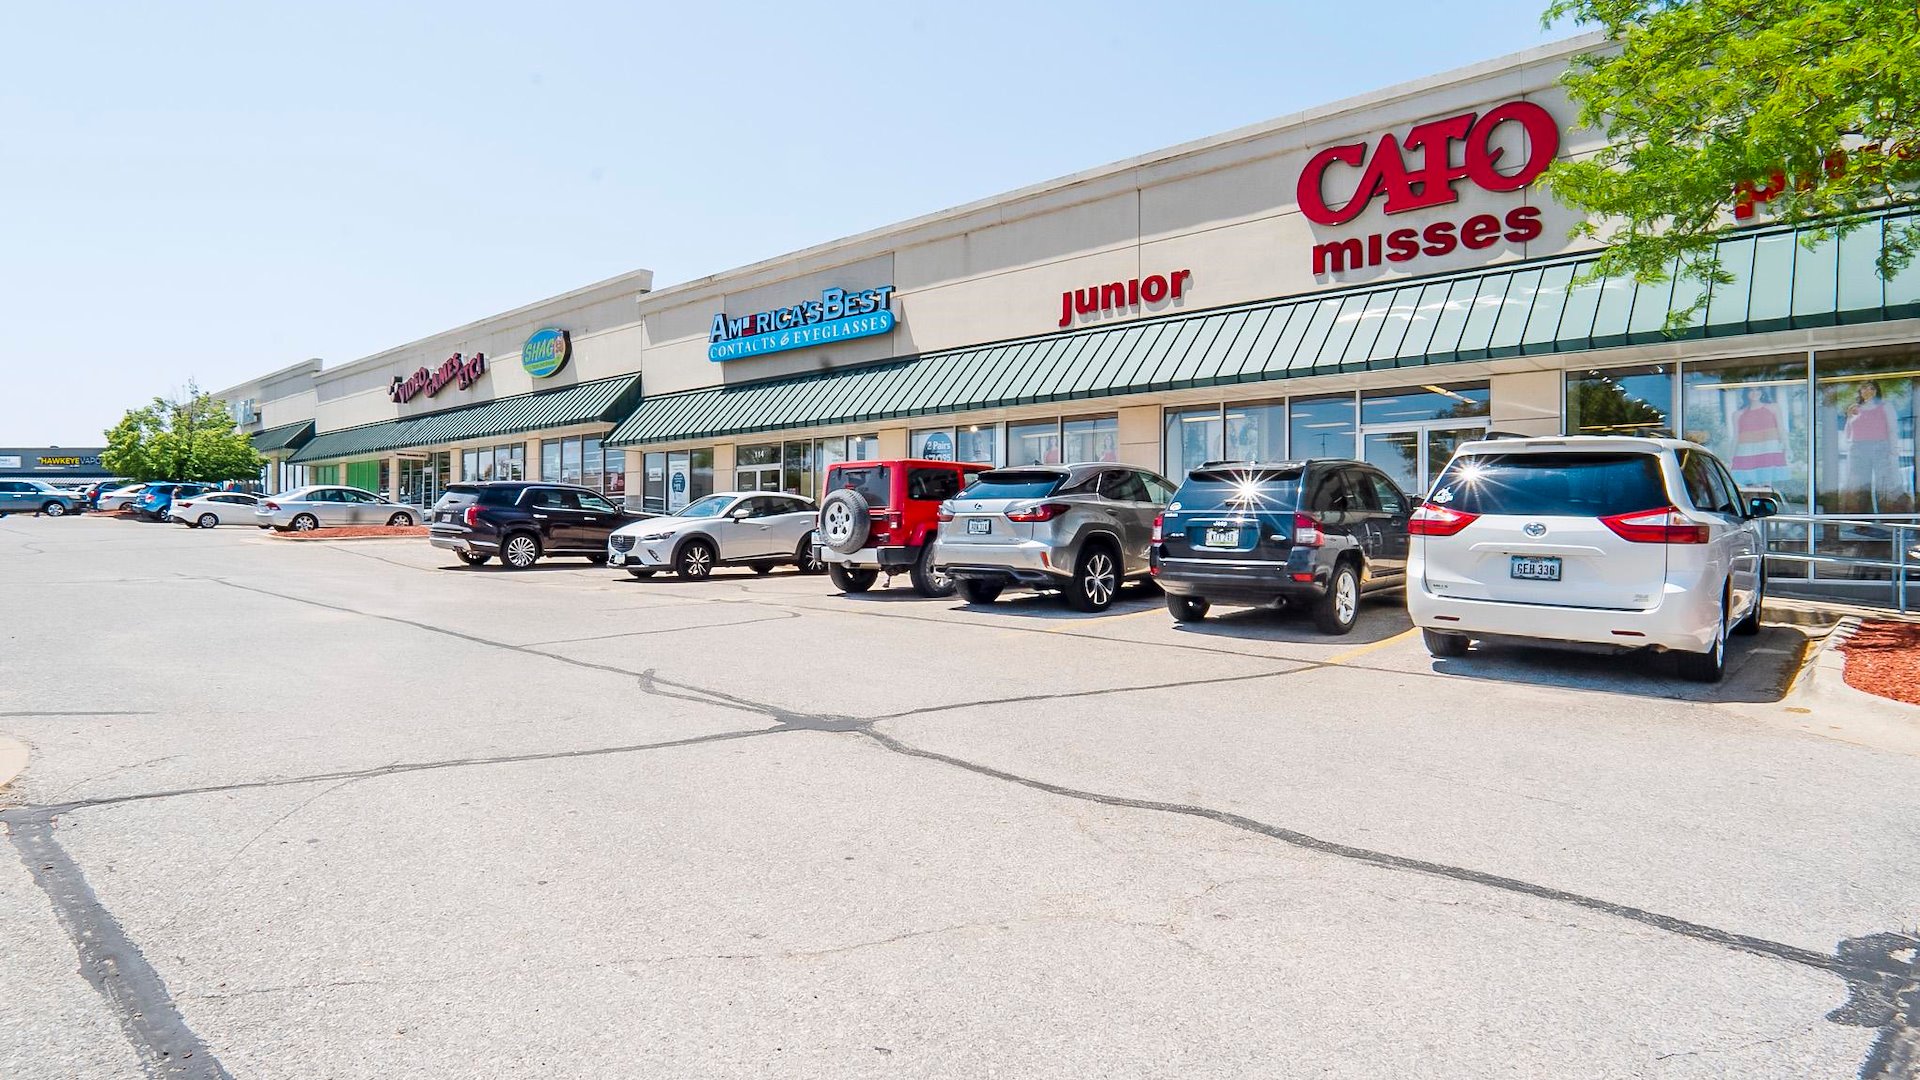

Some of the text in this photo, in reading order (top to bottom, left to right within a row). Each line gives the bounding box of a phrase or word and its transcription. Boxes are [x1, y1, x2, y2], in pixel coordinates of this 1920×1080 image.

[1296, 100, 1560, 226] CATO
[1312, 206, 1543, 275] misses
[1058, 269, 1191, 328] junior
[710, 337, 776, 359] CONTACTS
[794, 315, 888, 344] EYEGLASSES
[398, 366, 429, 404] VIDEO
[423, 352, 463, 398] GAMES
[41, 457, 80, 465] HAWKEYE
[926, 440, 951, 450] 2 Pairs
[1517, 563, 1555, 576] GEH 336
